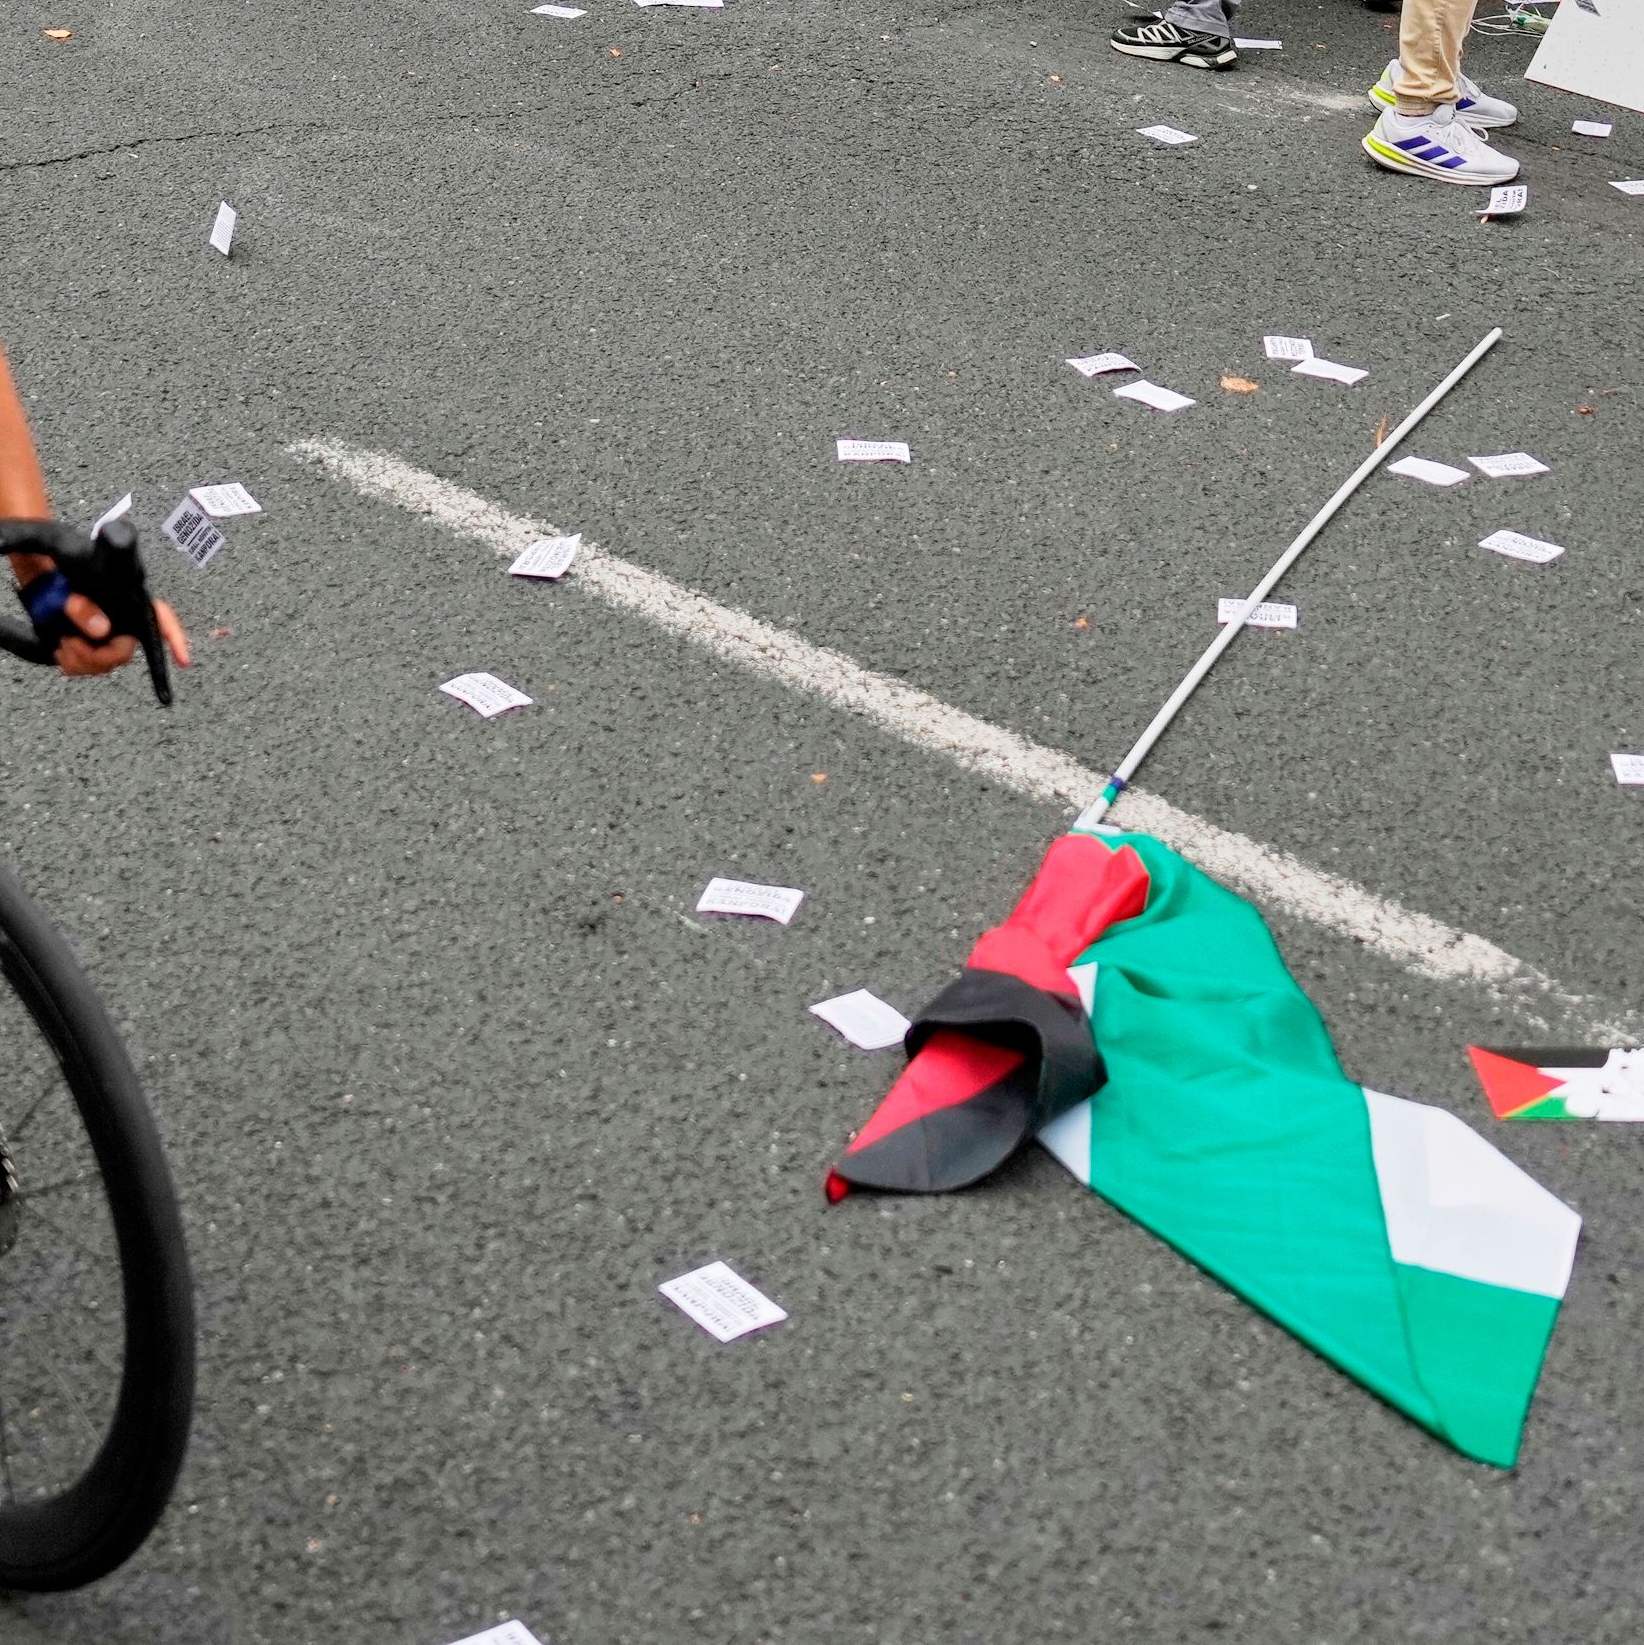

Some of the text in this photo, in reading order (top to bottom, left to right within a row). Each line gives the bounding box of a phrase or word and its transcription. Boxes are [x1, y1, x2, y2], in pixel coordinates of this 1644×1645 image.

[171, 510, 192, 534] ISRAEL
[176, 515, 203, 545] GENOZIDA
[194, 533, 222, 566] KANPORA!
